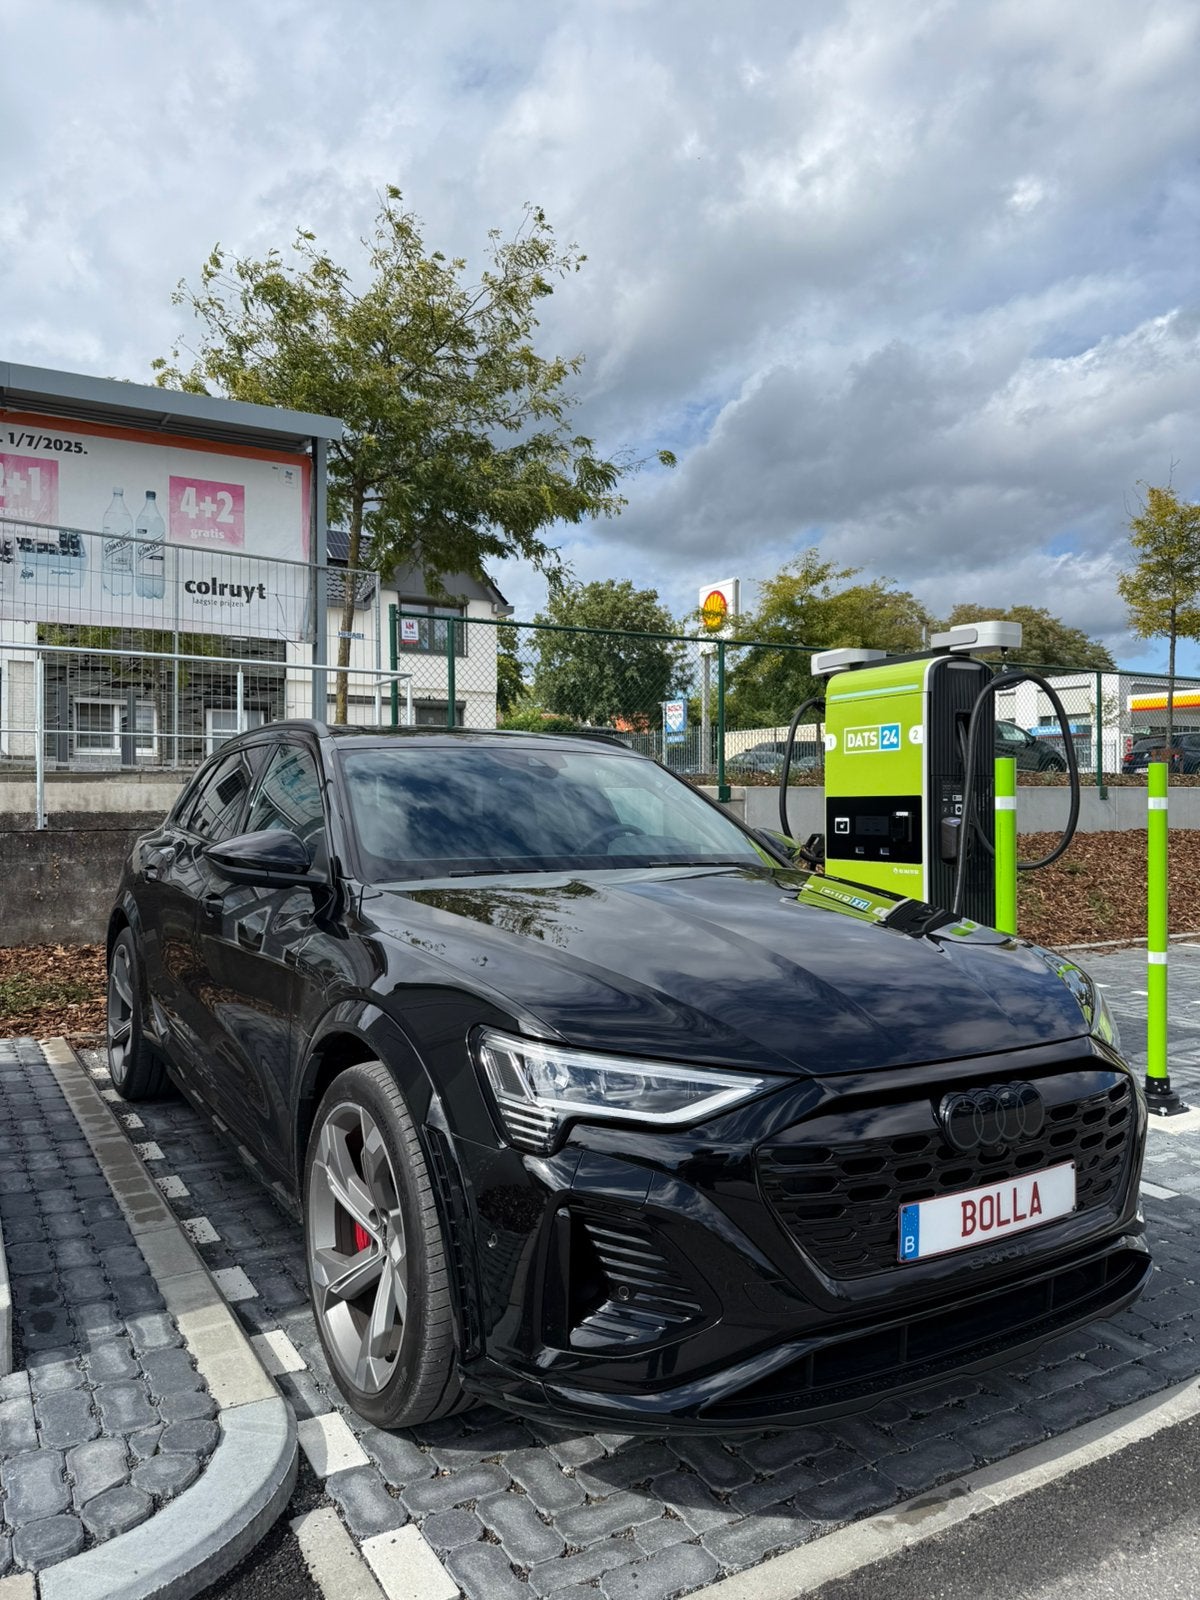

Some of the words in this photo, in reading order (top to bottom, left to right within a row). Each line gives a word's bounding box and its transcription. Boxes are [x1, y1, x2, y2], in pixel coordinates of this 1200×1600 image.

[8, 432, 88, 455] 1/7/2025.
[180, 486, 235, 524] 4+2
[190, 528, 225, 540] gratis
[184, 577, 266, 604] colruyt
[847, 731, 878, 748] DATS
[882, 728, 898, 745] 24
[912, 729, 919, 740] 2
[961, 1181, 1042, 1237] BOLLA
[904, 1236, 915, 1253] B
